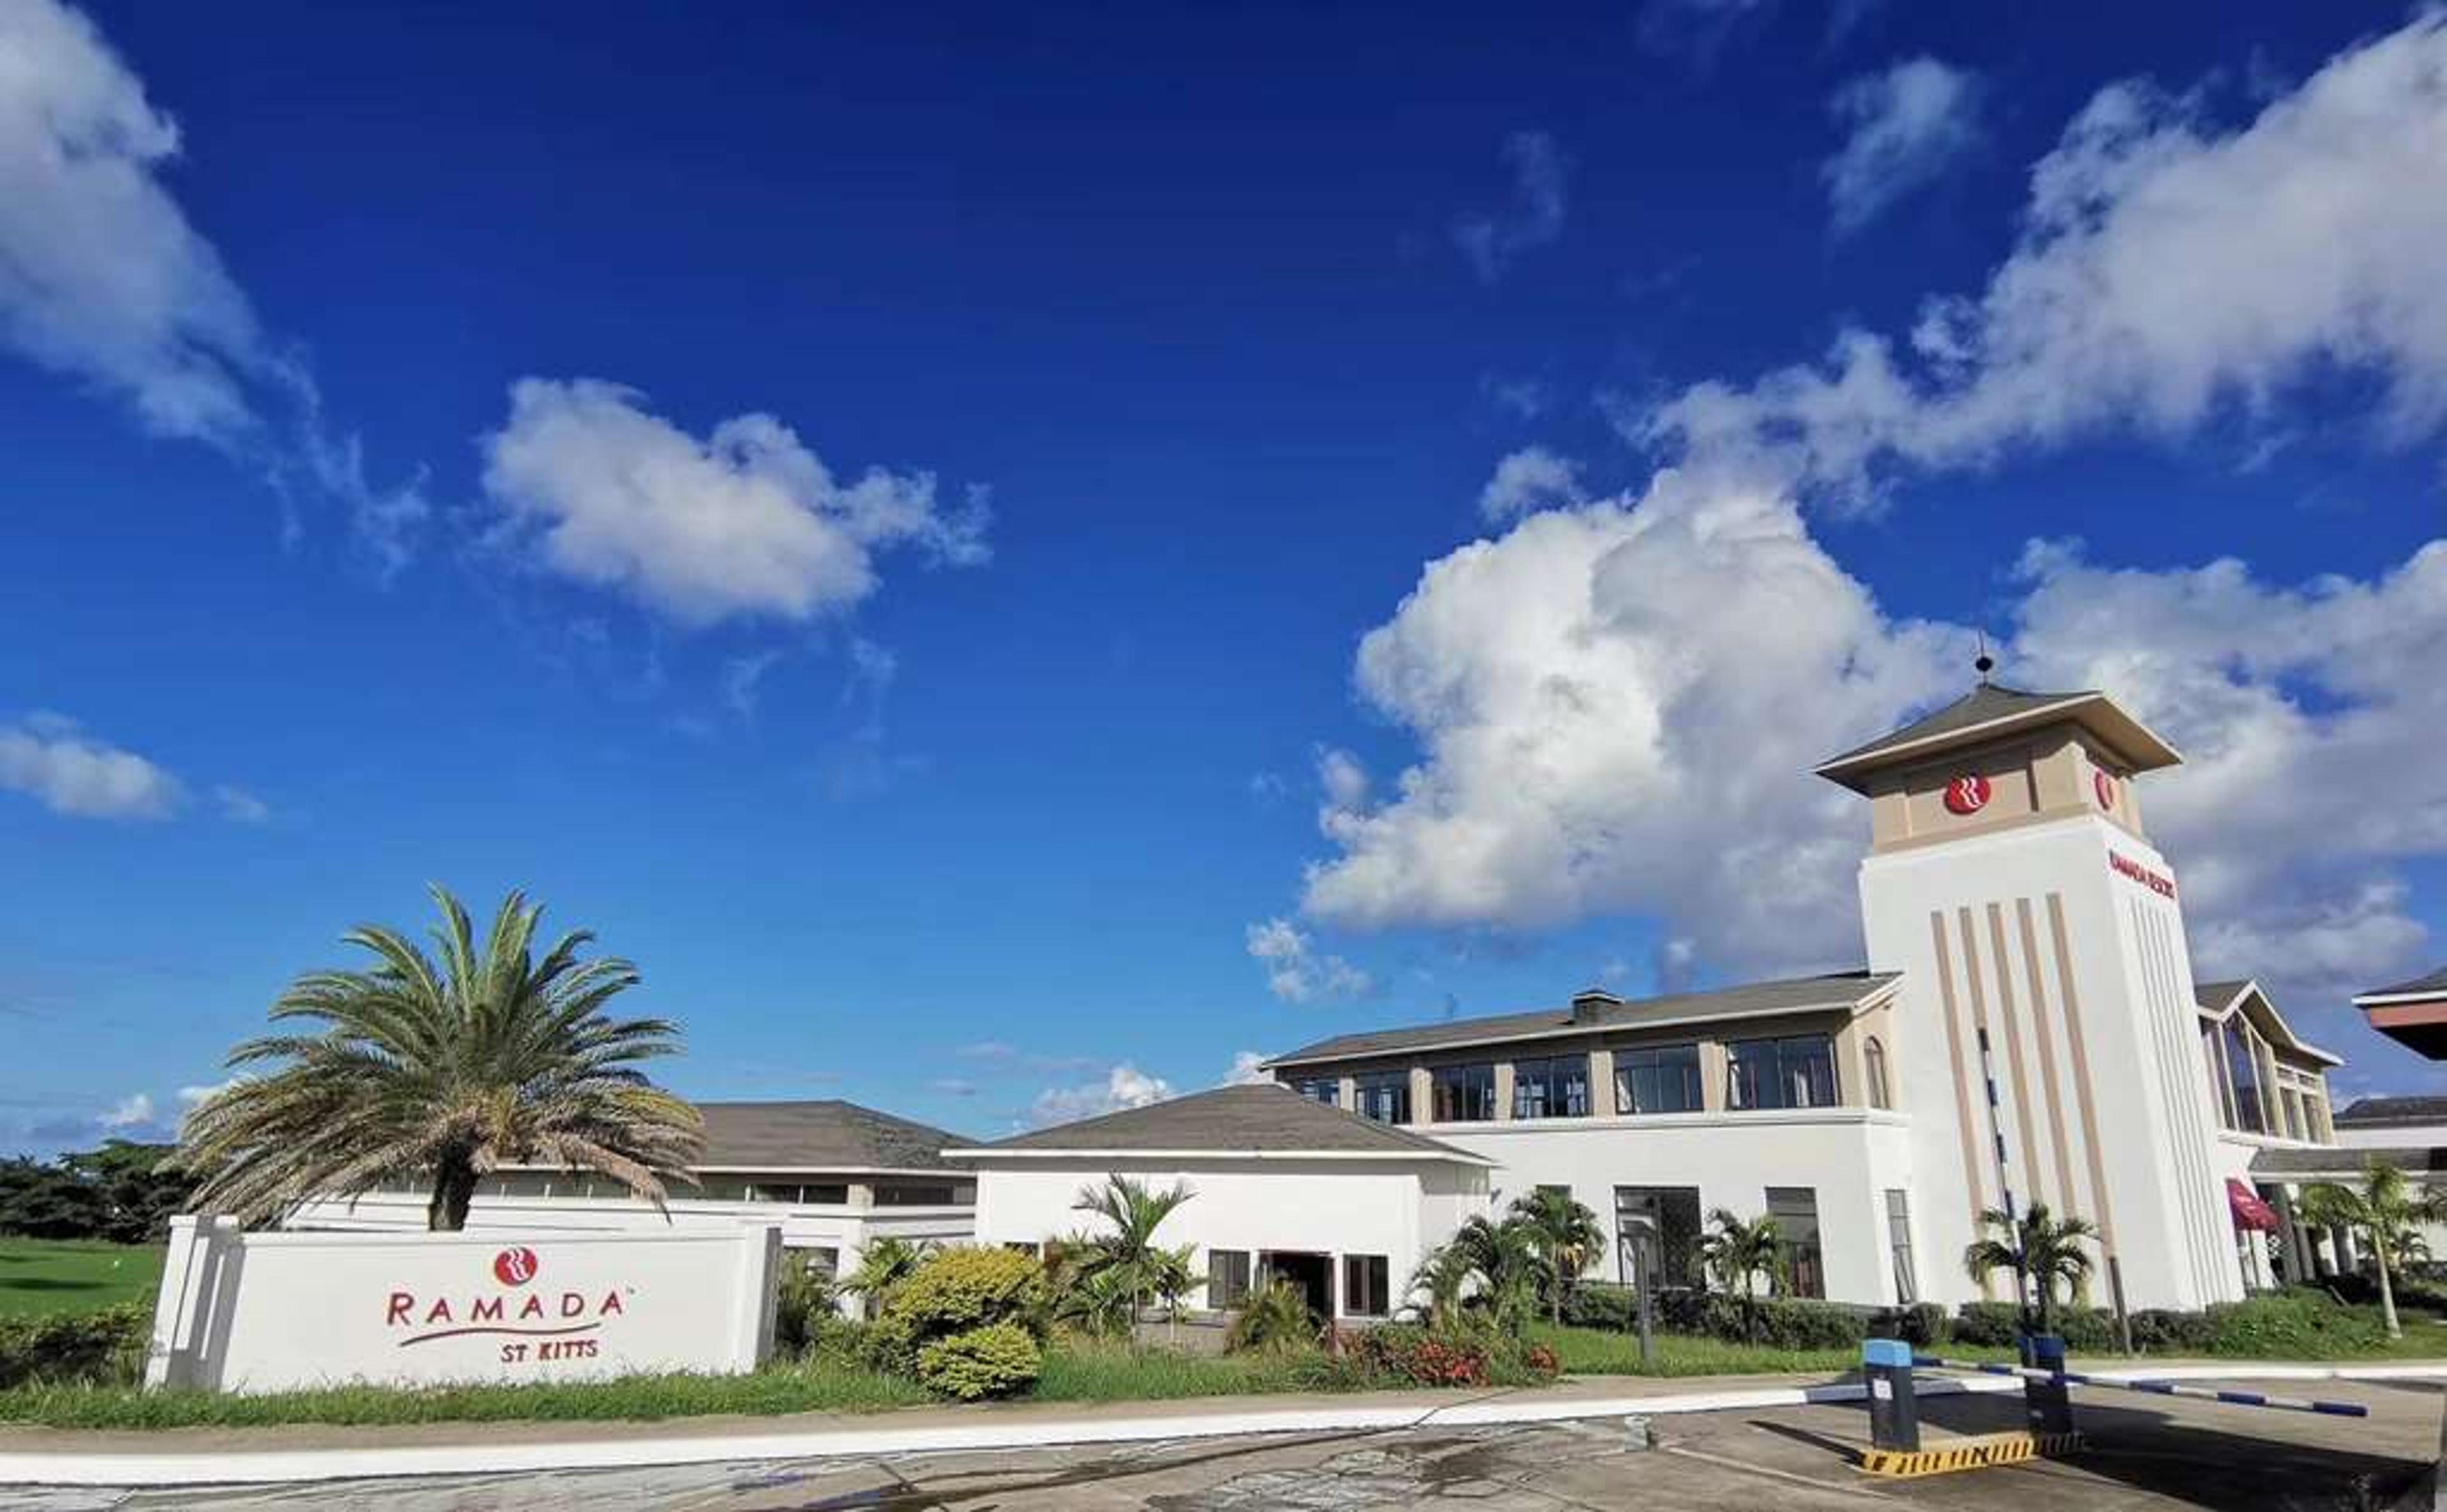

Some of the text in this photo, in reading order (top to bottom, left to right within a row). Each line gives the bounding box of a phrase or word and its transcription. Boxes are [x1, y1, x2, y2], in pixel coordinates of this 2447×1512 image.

[387, 1291, 622, 1326] RAMADA
[501, 1339, 598, 1363] ST KITTS
